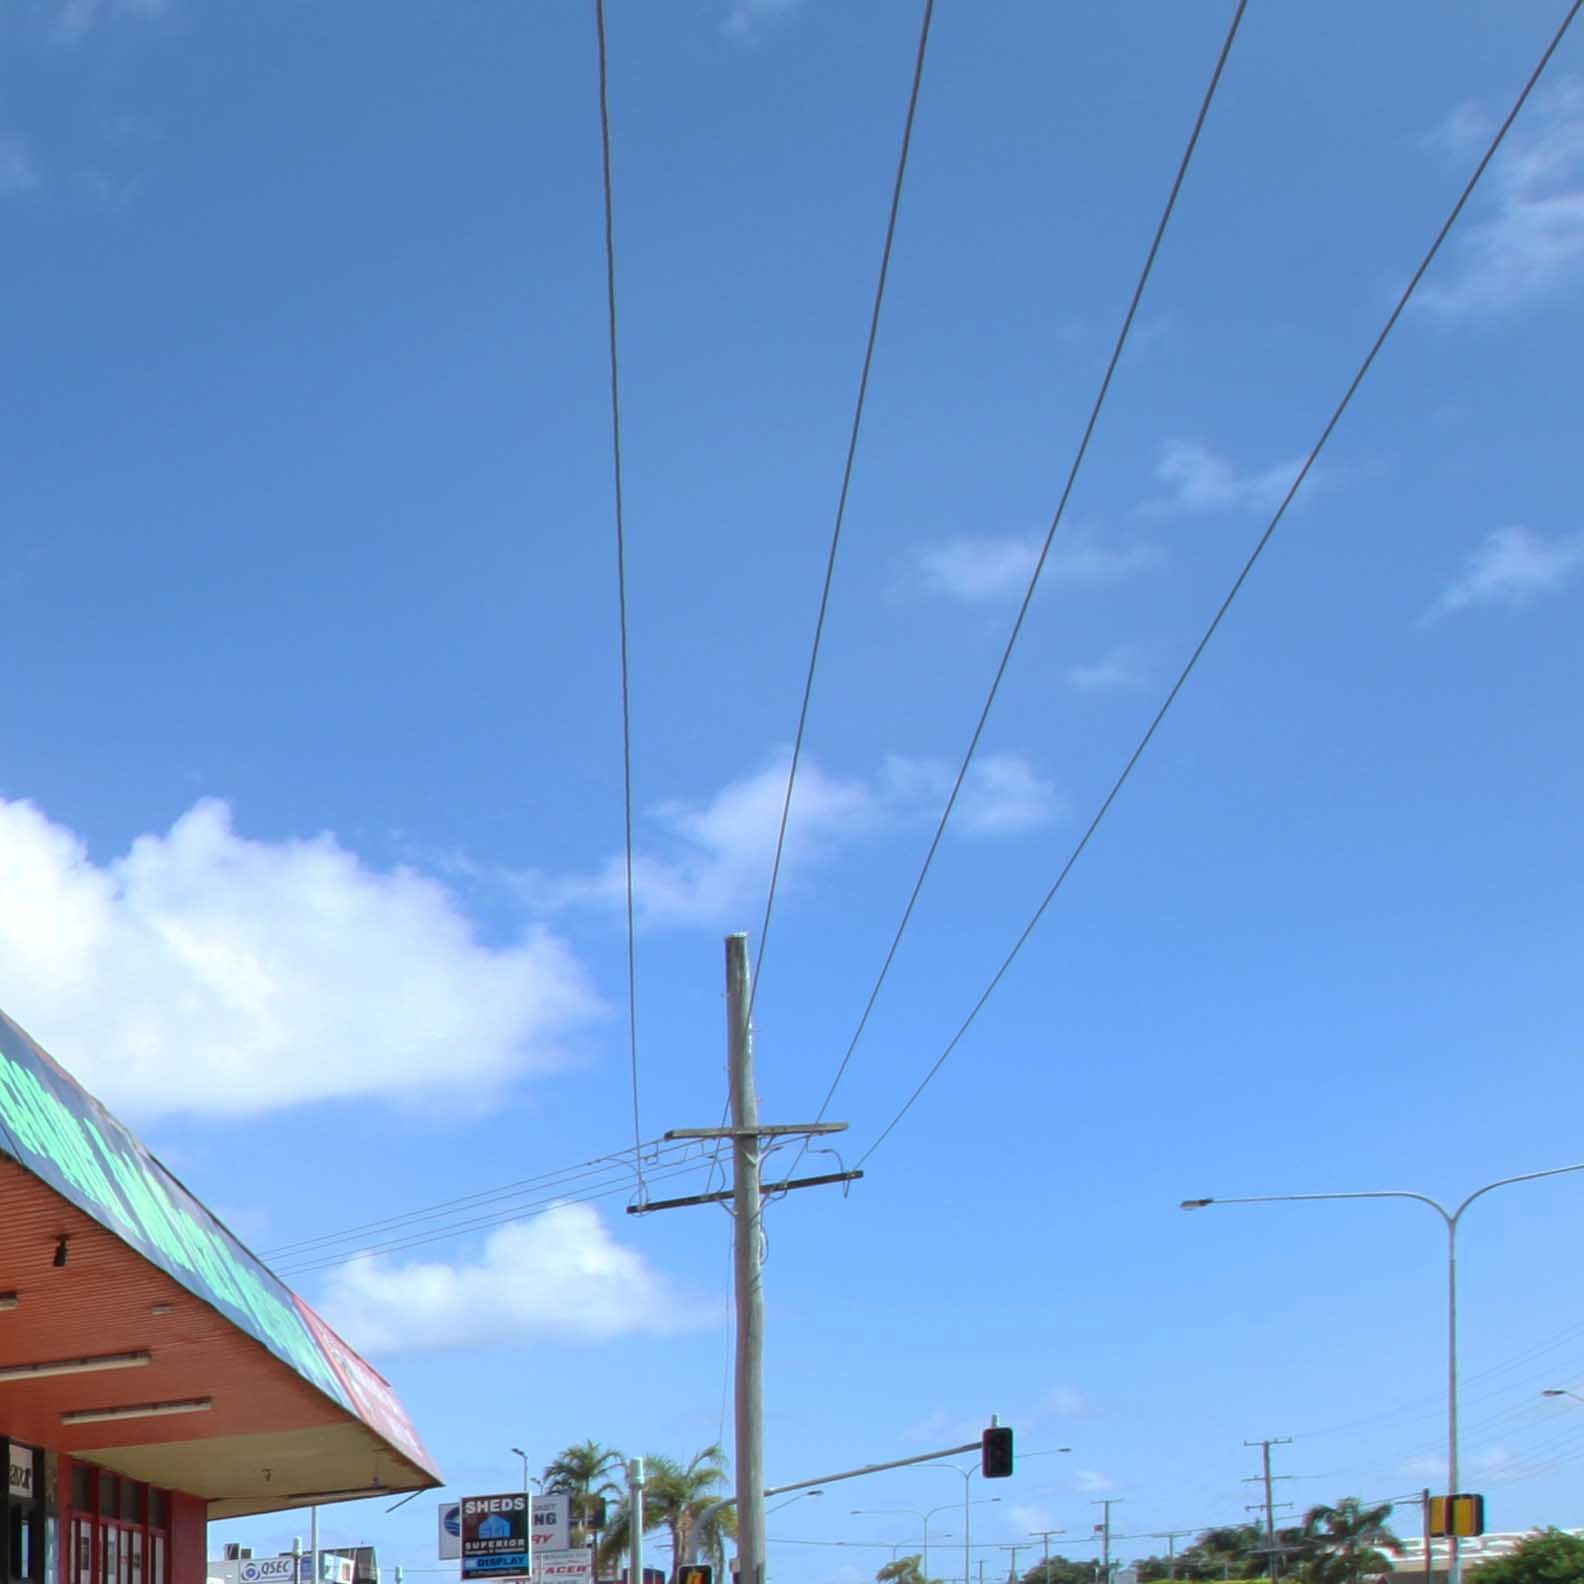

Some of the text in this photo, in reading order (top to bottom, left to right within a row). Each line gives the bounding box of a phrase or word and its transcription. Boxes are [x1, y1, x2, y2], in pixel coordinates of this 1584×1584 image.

[465, 1497, 525, 1514] SHEDS
[534, 1513, 557, 1526] NG
[464, 1539, 525, 1550] SUPERIOR
[261, 1560, 290, 1575] QSEC
